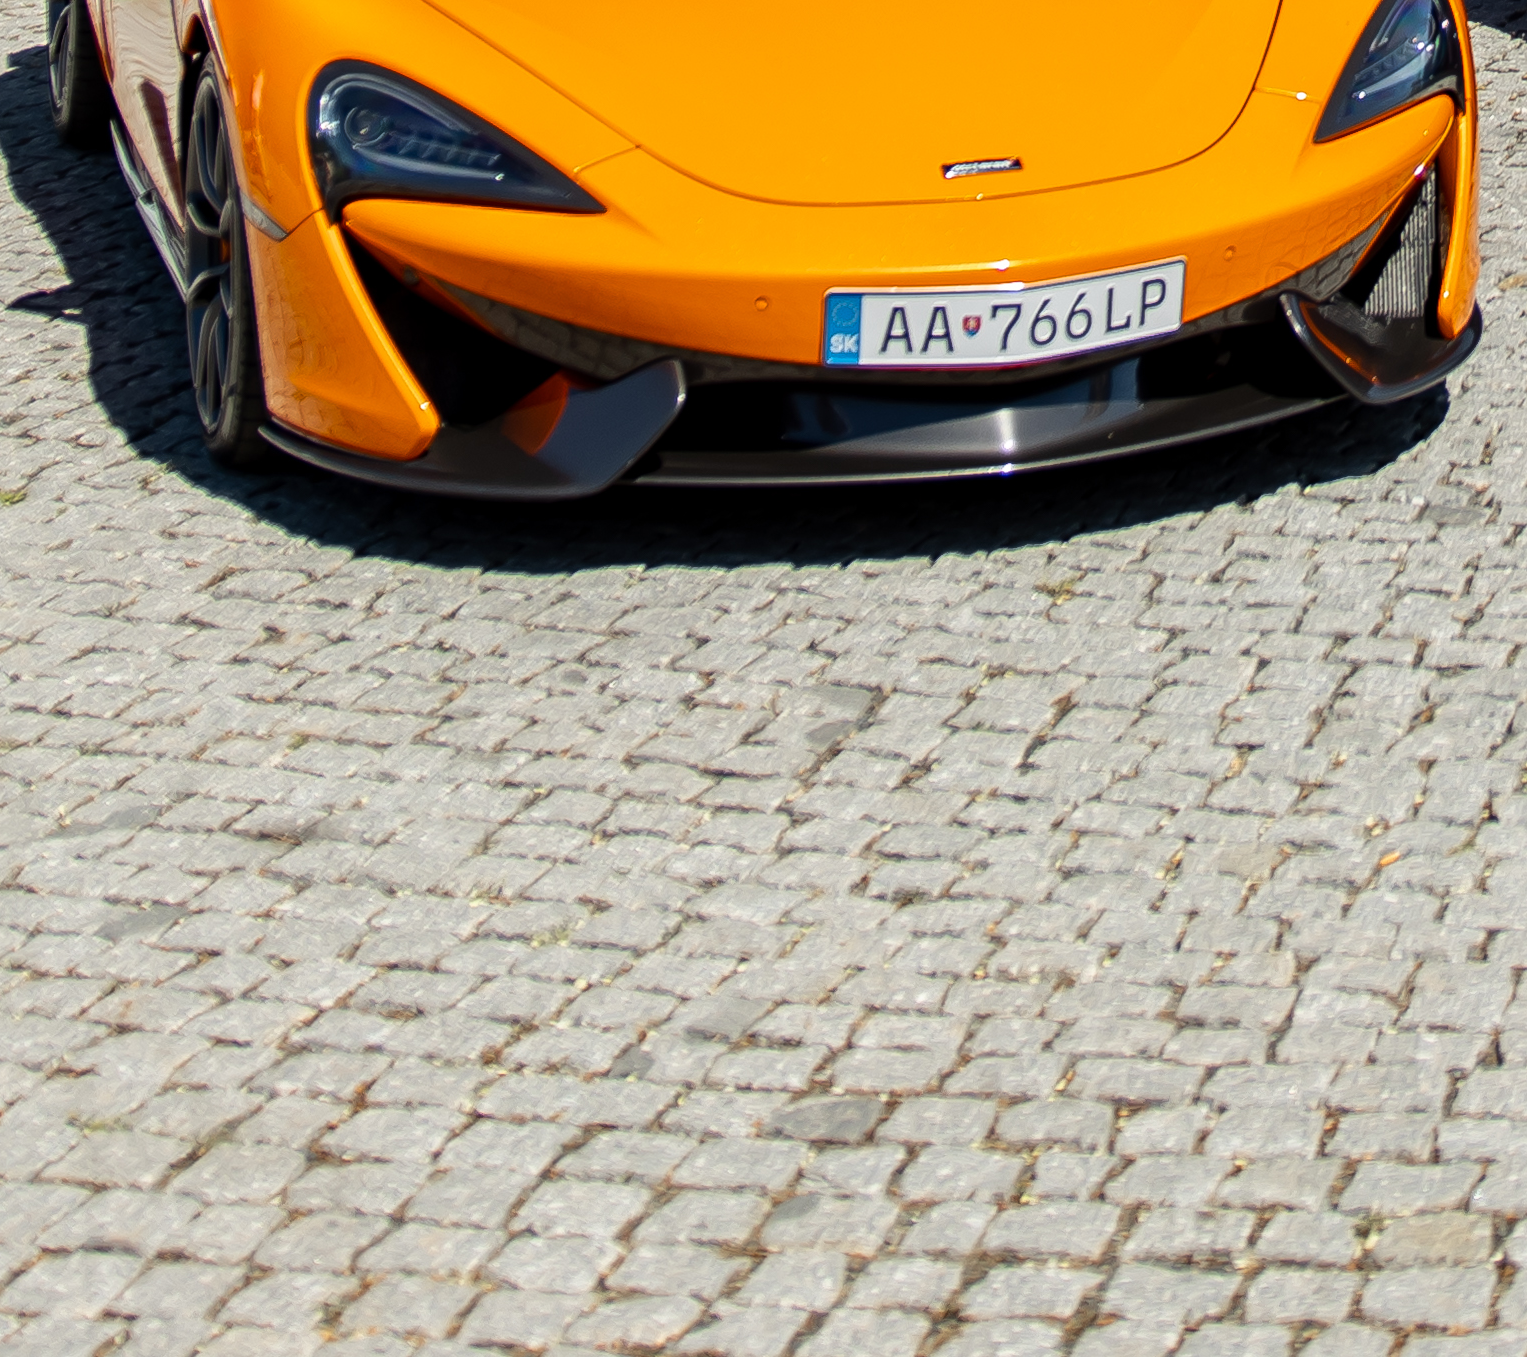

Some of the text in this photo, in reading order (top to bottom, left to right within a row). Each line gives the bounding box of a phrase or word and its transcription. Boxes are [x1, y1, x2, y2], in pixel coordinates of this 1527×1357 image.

[830, 278, 1167, 355] SK AA 766LP
